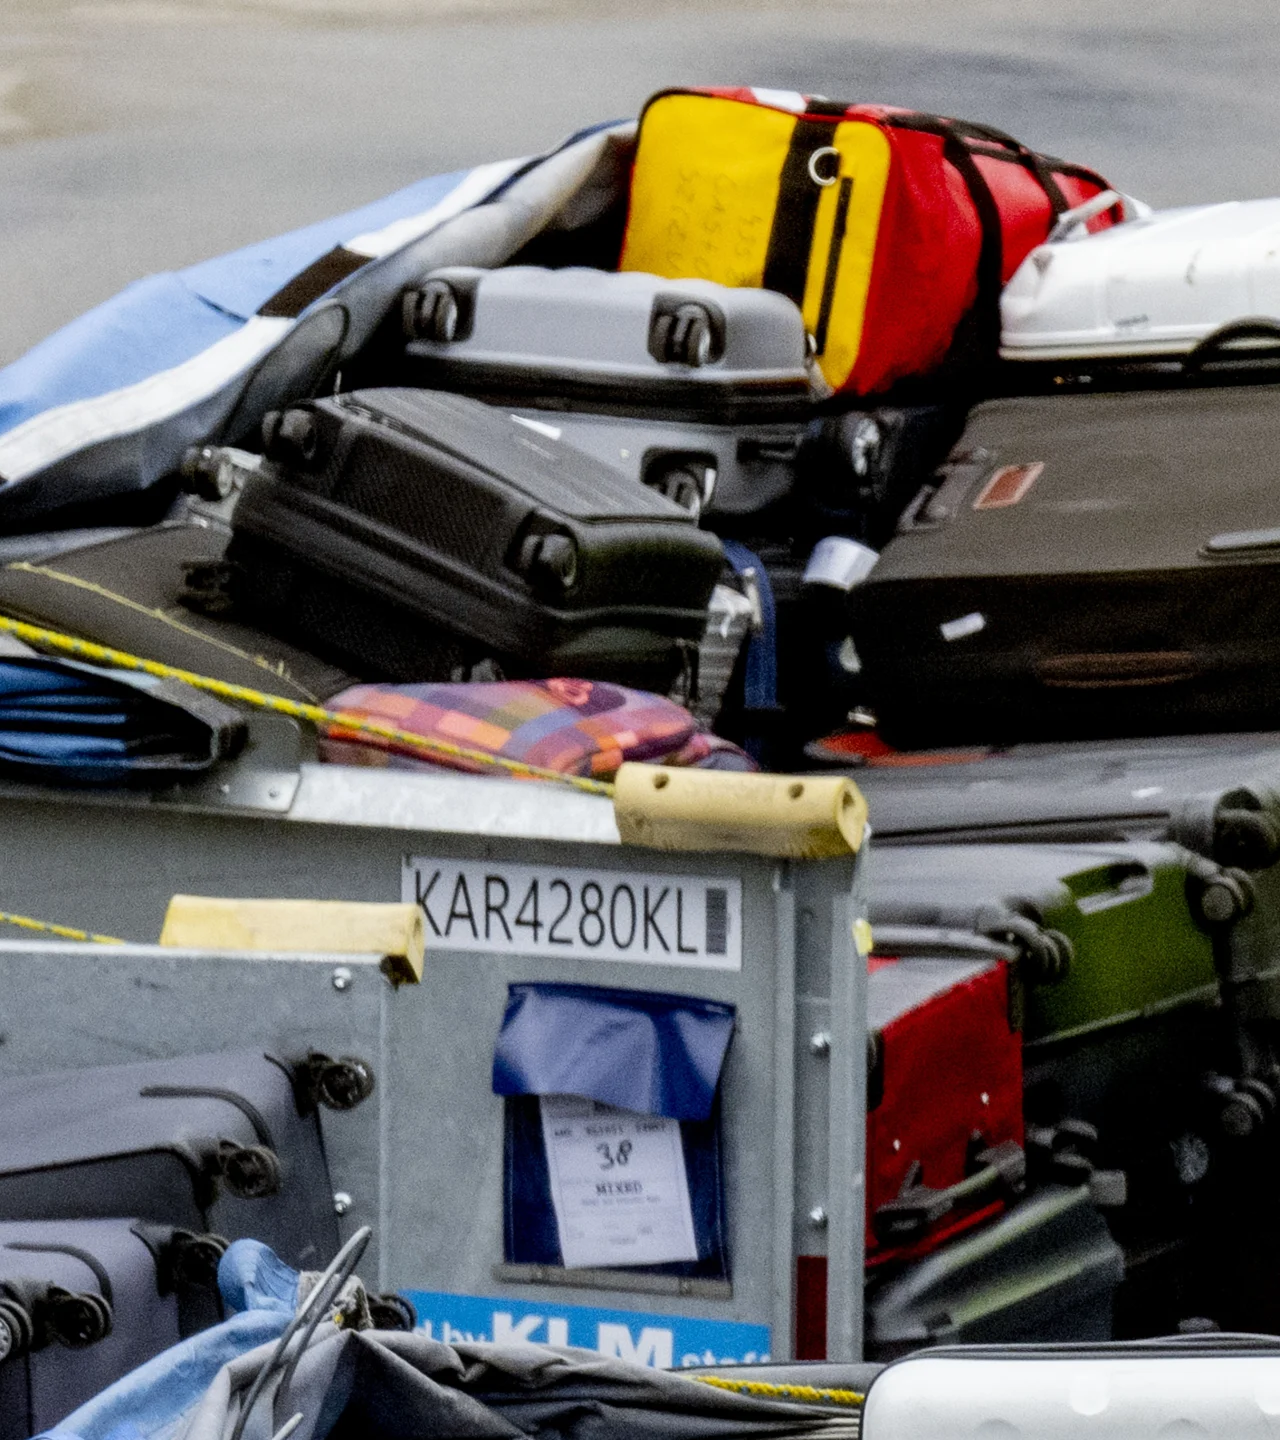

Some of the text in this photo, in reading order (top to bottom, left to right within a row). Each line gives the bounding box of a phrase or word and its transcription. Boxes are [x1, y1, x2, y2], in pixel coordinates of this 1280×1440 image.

[414, 868, 699, 954] KAR4280KL
[596, 1139, 633, 1171] 38
[596, 1180, 644, 1196] MIXED
